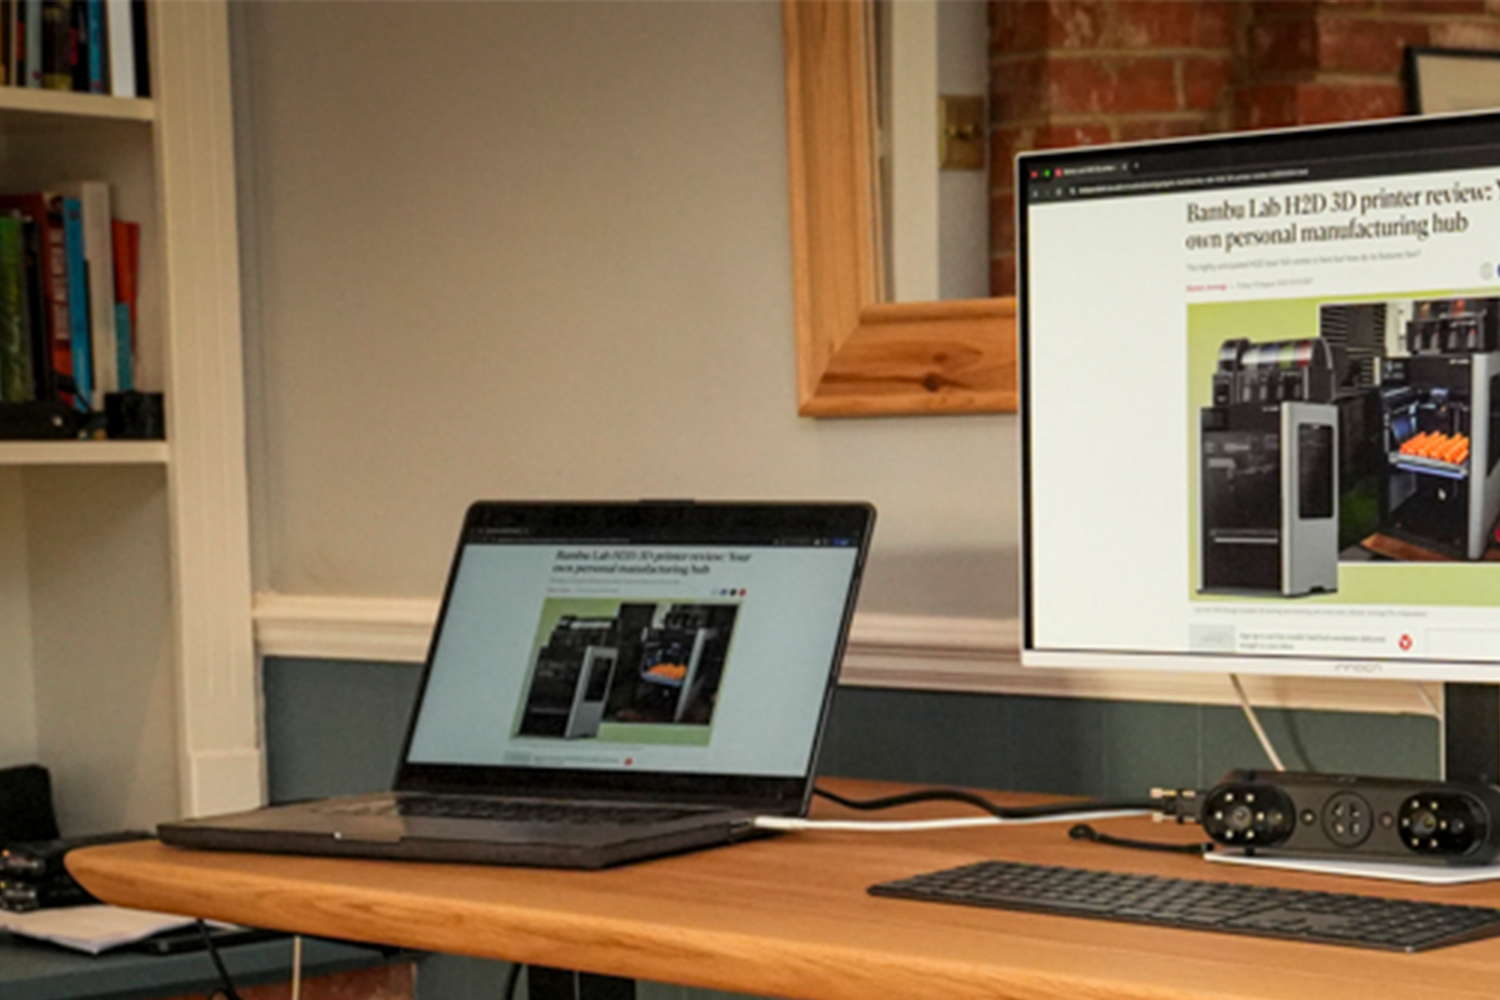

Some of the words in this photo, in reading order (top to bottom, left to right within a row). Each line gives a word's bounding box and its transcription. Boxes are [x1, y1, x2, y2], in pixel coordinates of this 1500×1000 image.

[1186, 200, 1246, 223] Bambu
[1250, 197, 1282, 219] Lab
[1285, 193, 1327, 216] H2D
[1330, 190, 1357, 212] 3D
[1360, 187, 1422, 215] printer
[1426, 181, 1492, 207] review:
[1185, 233, 1222, 250] own
[1225, 223, 1297, 253] personal
[1300, 214, 1429, 242] manufacturing
[1432, 210, 1469, 233] hub
